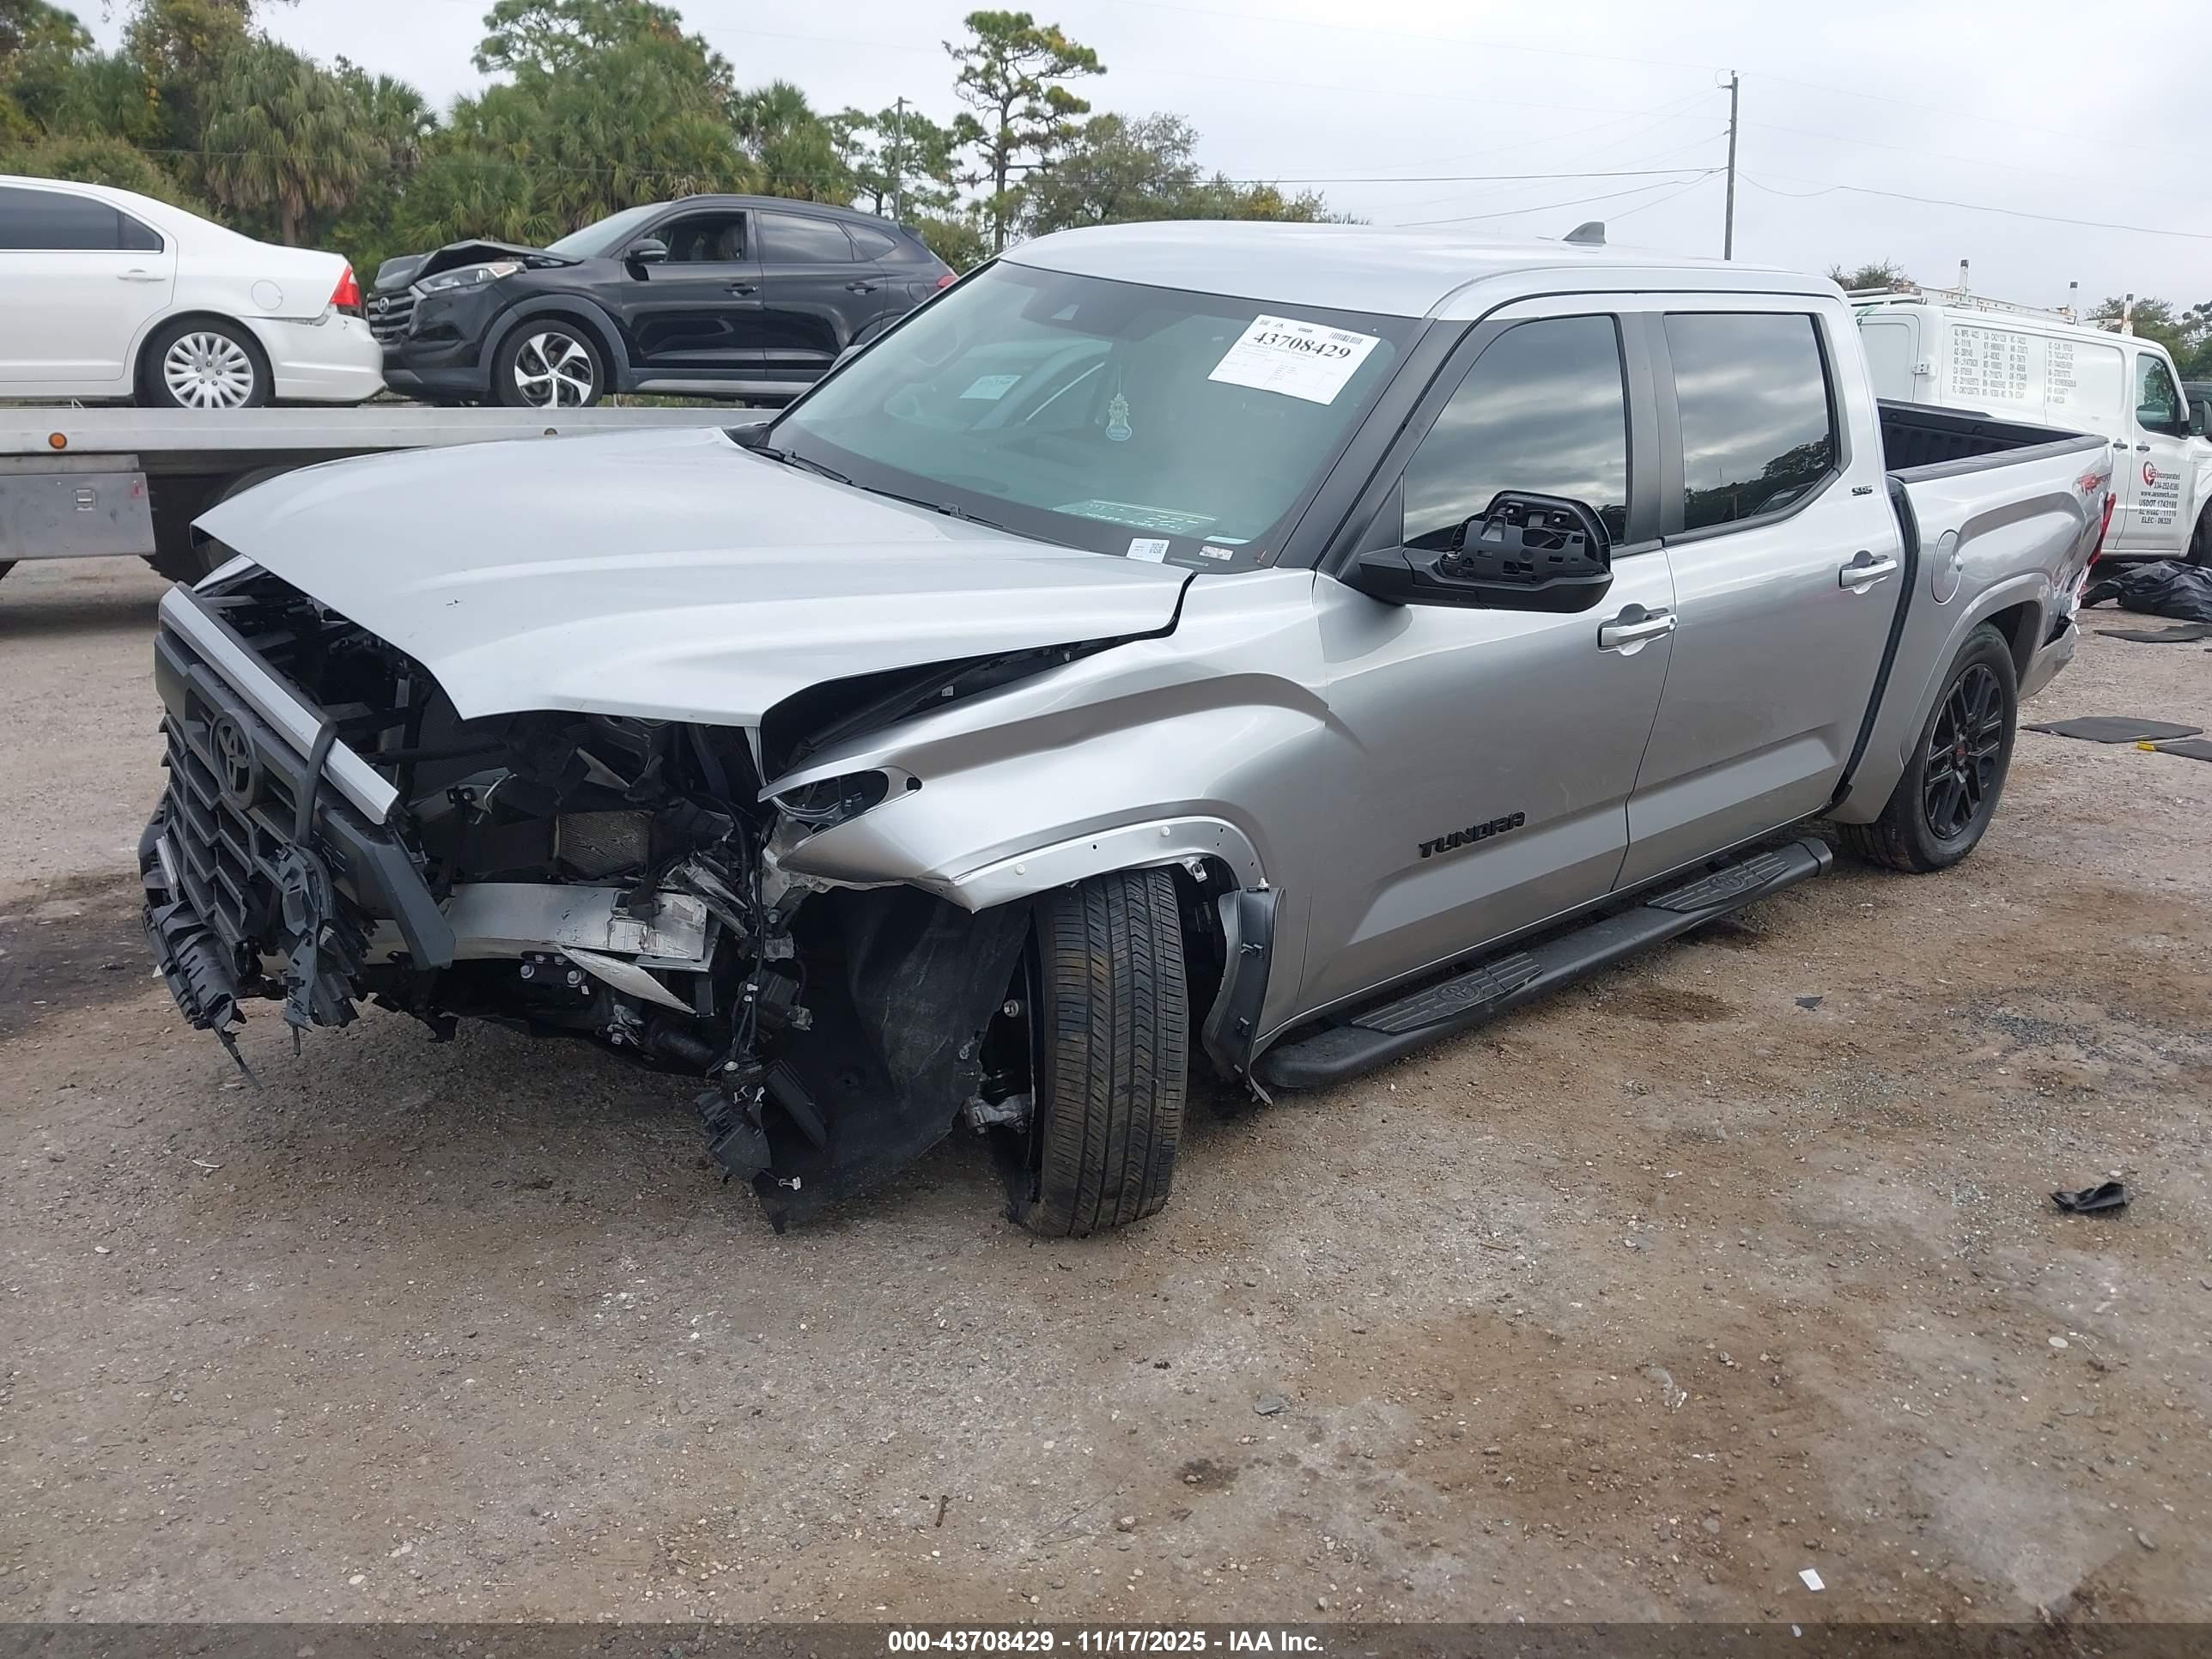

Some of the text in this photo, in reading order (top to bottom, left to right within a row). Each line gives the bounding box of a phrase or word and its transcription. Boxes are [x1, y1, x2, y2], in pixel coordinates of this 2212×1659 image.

[1254, 332, 1352, 359] 43708429
[2138, 499, 2156, 507] USDOT
[2141, 516, 2154, 525] ELEC
[1419, 811, 1526, 859] TUNDRA
